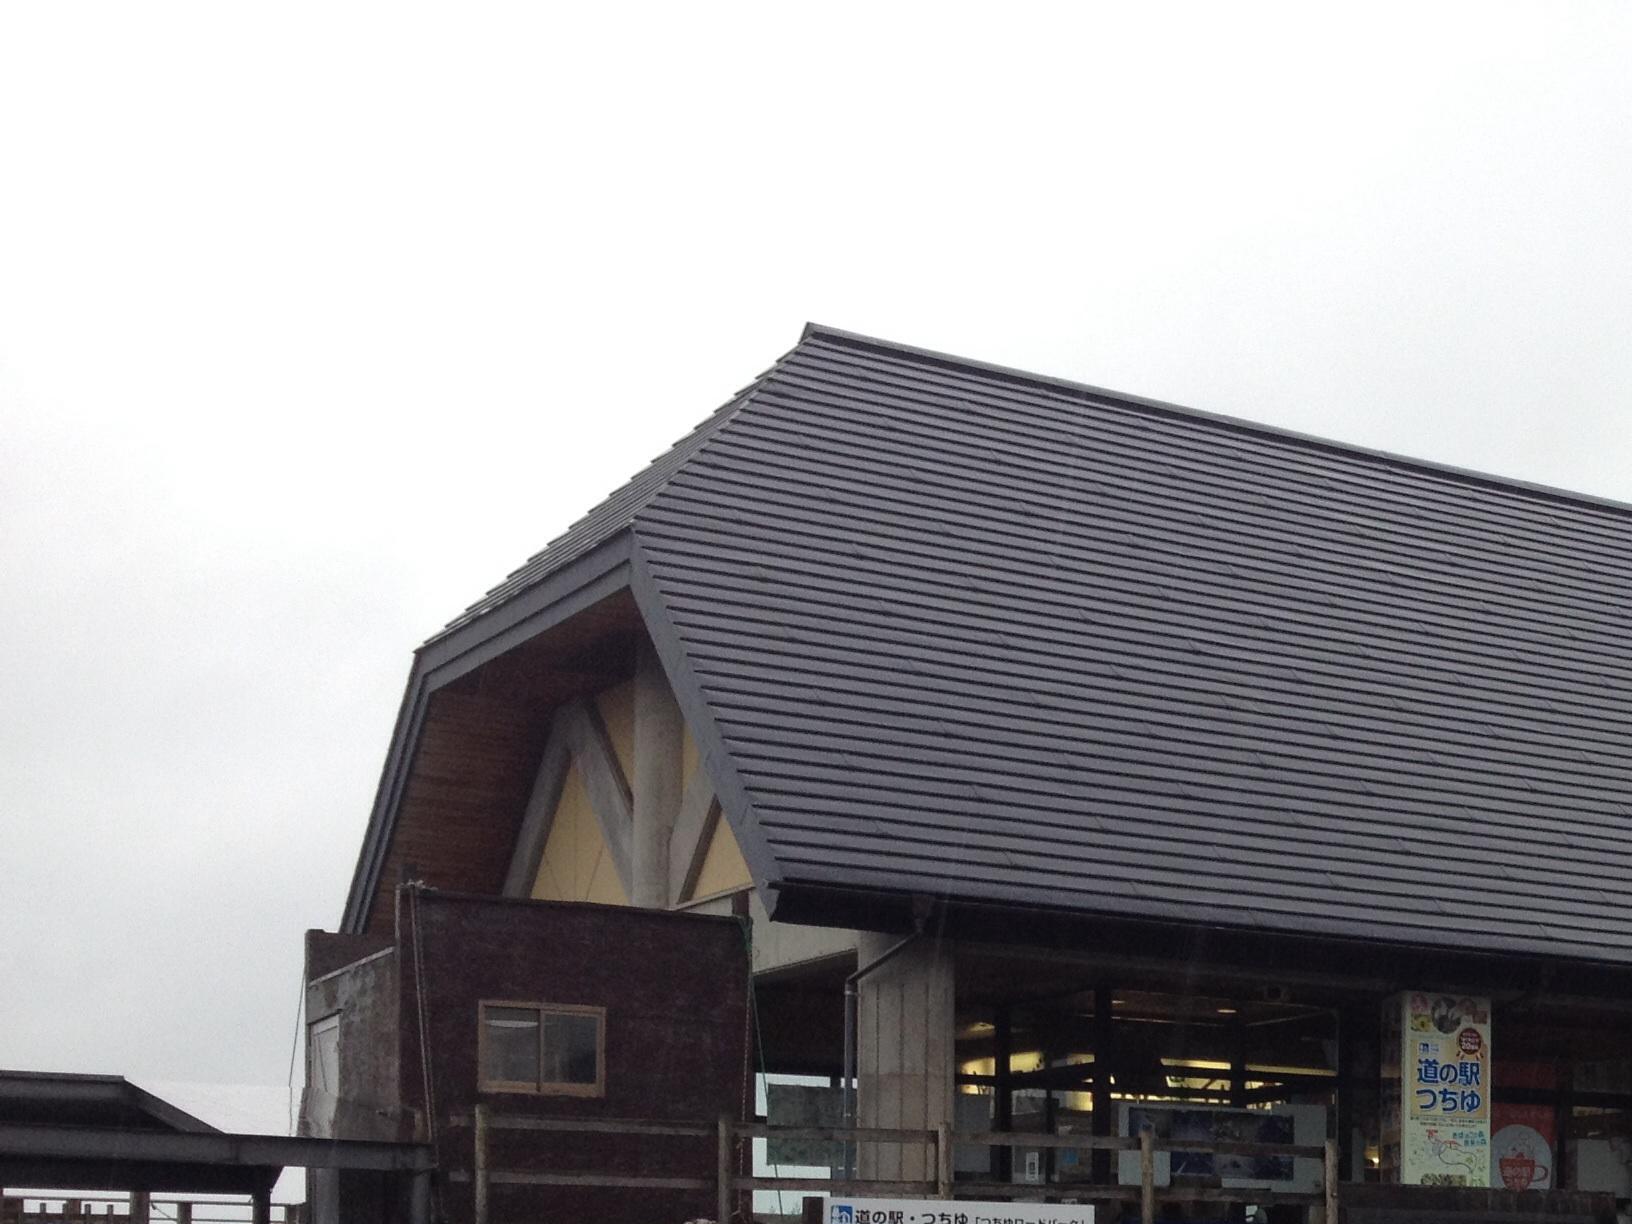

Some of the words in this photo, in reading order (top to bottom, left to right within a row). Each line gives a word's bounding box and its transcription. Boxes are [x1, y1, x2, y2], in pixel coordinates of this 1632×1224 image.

[1417, 1059, 1480, 1085] 道の駅
[1416, 1088, 1481, 1112] つちゆ
